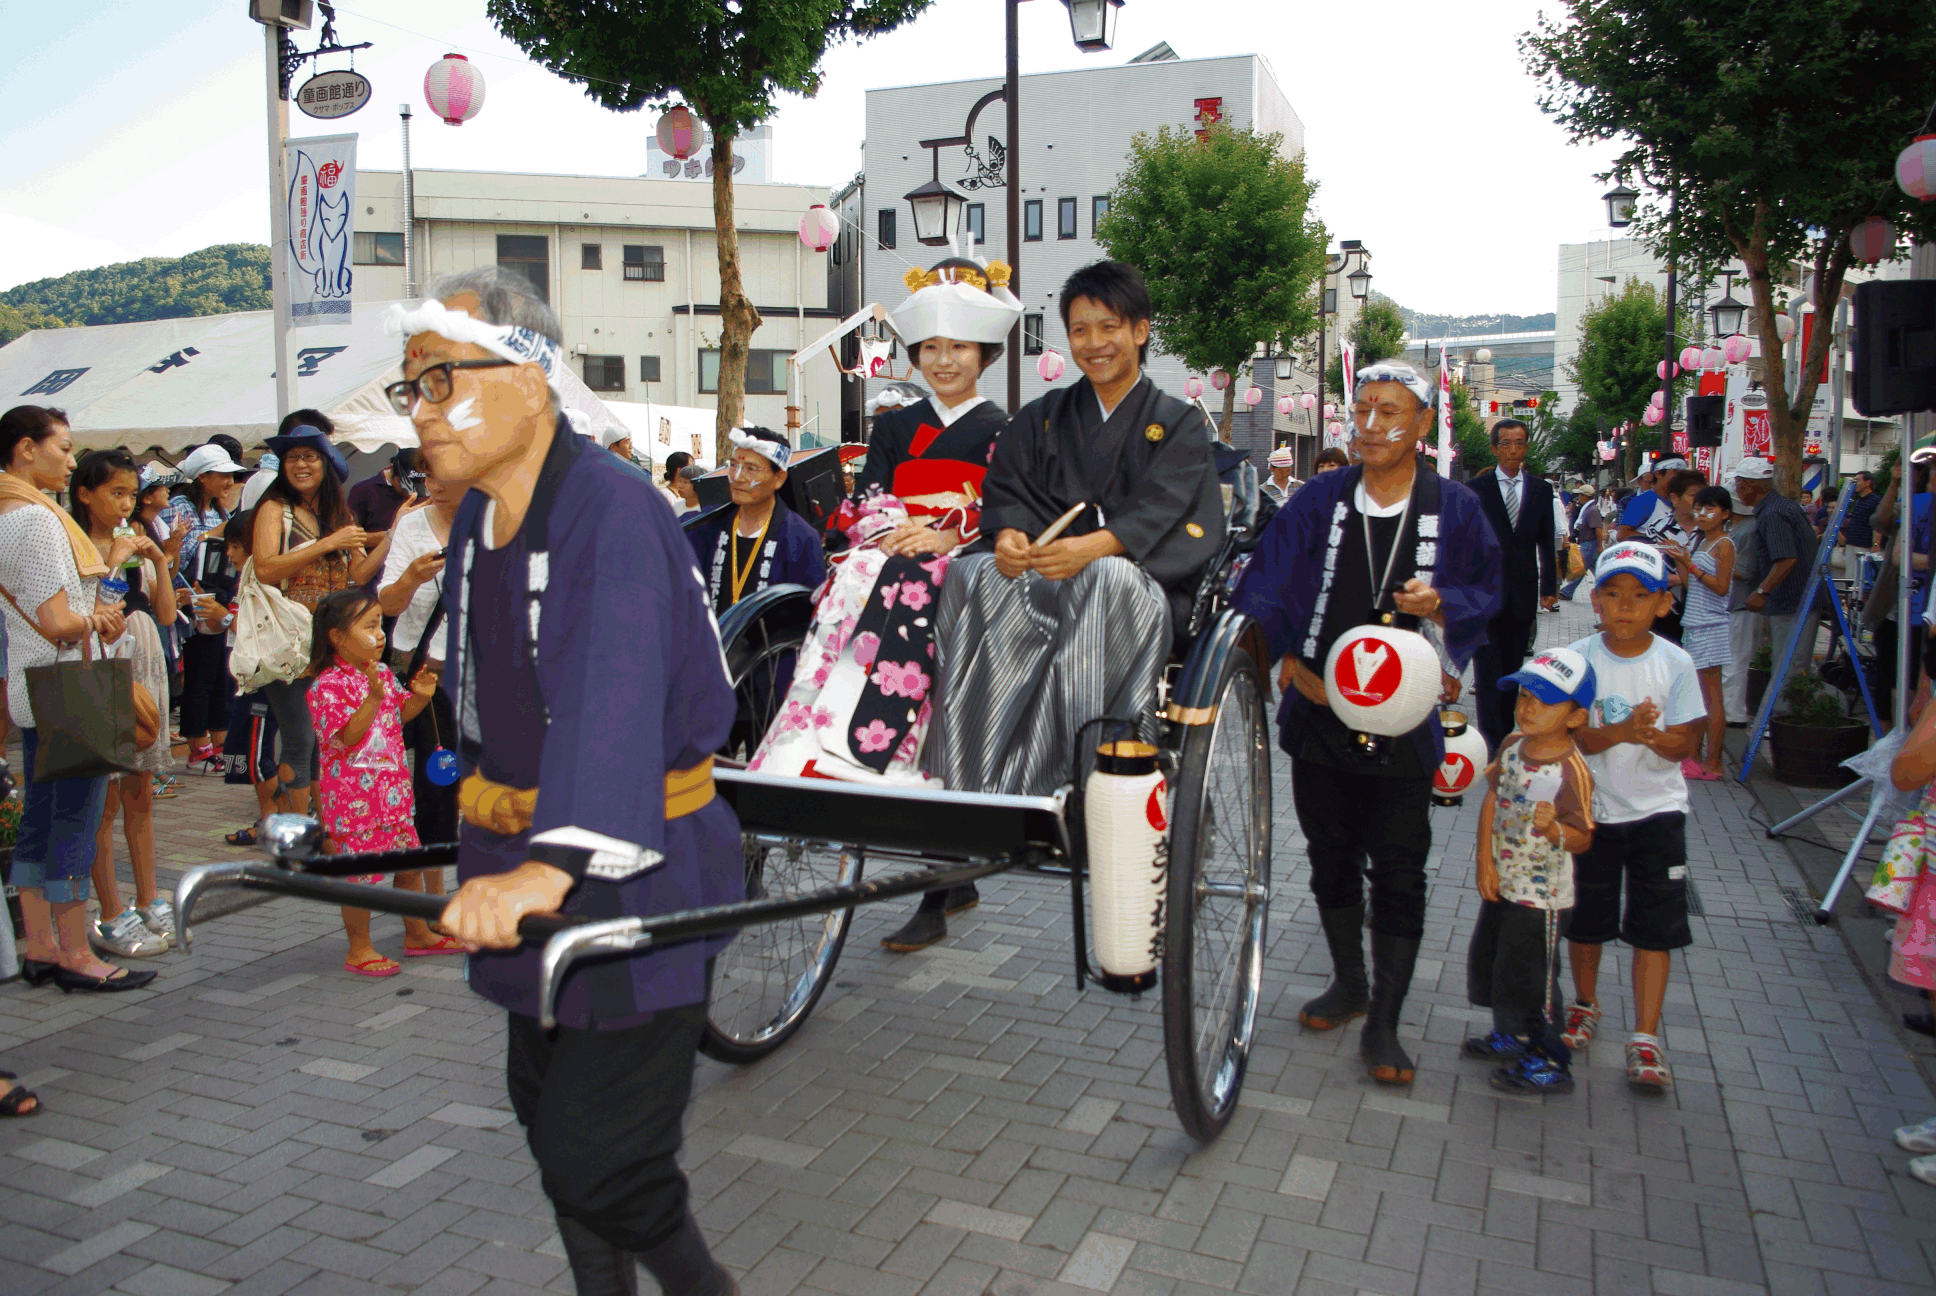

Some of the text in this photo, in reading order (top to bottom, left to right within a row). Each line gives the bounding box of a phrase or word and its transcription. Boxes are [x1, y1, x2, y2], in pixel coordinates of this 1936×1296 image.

[303, 81, 365, 104] 童画館通り
[319, 164, 337, 187] 福
[223, 754, 248, 774] 75
